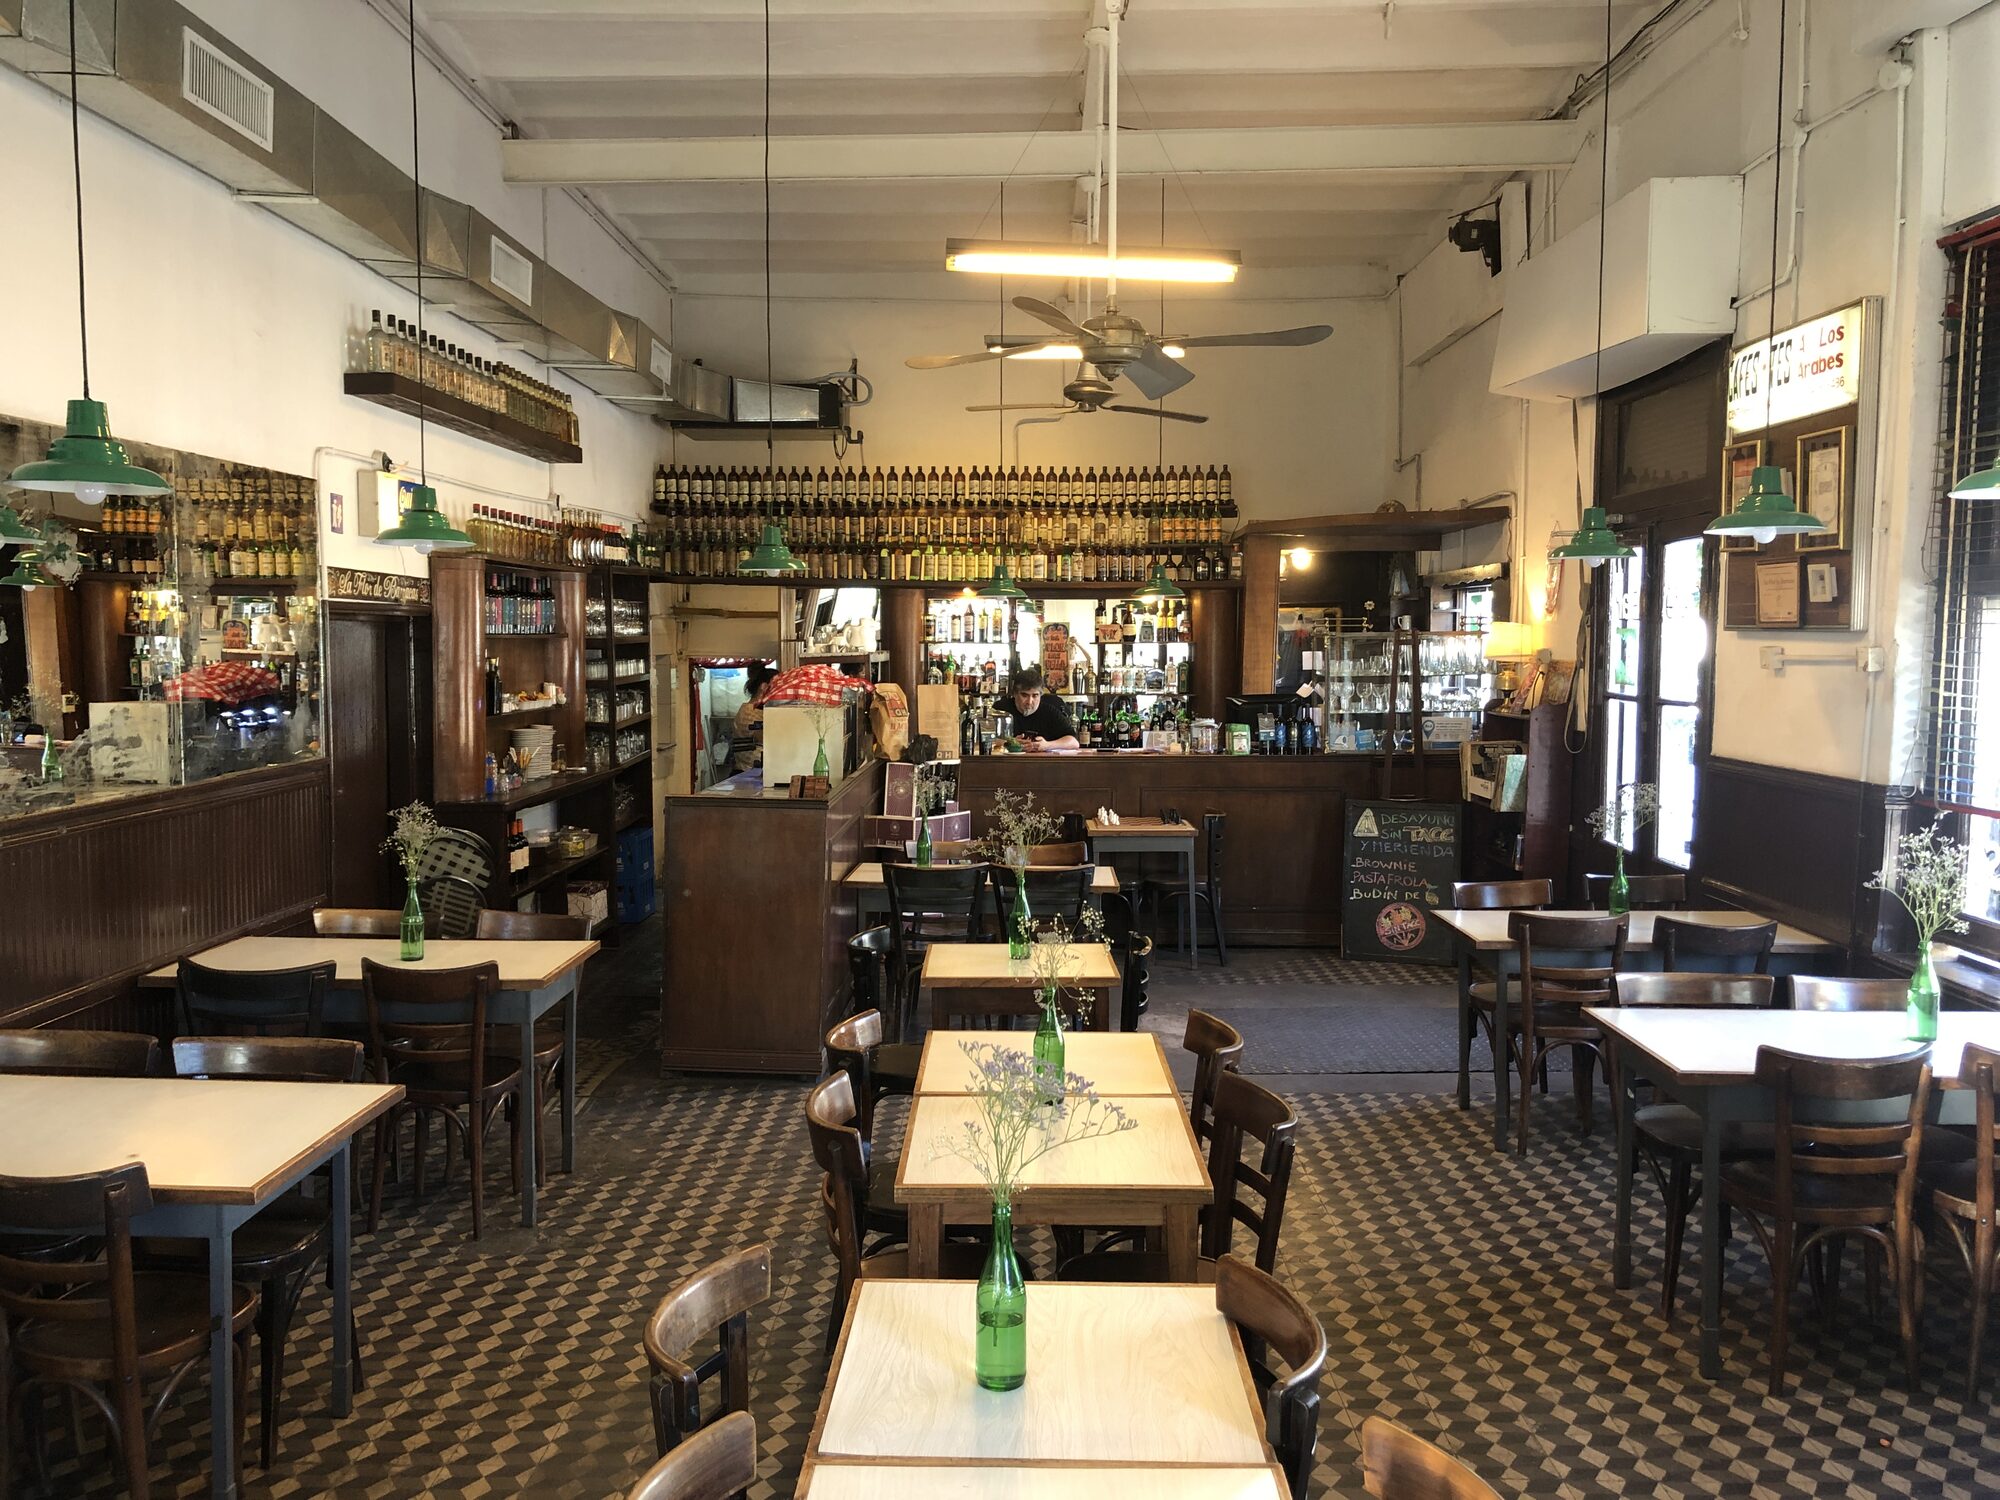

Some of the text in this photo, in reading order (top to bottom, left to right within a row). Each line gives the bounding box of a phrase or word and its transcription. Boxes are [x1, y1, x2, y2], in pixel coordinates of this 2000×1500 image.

[1819, 325, 1846, 348] Los
[338, 571, 352, 594] La
[353, 571, 373, 596] Flor
[373, 575, 383, 597] de
[1360, 840, 1369, 851] Y
[1405, 891, 1420, 900] DE
